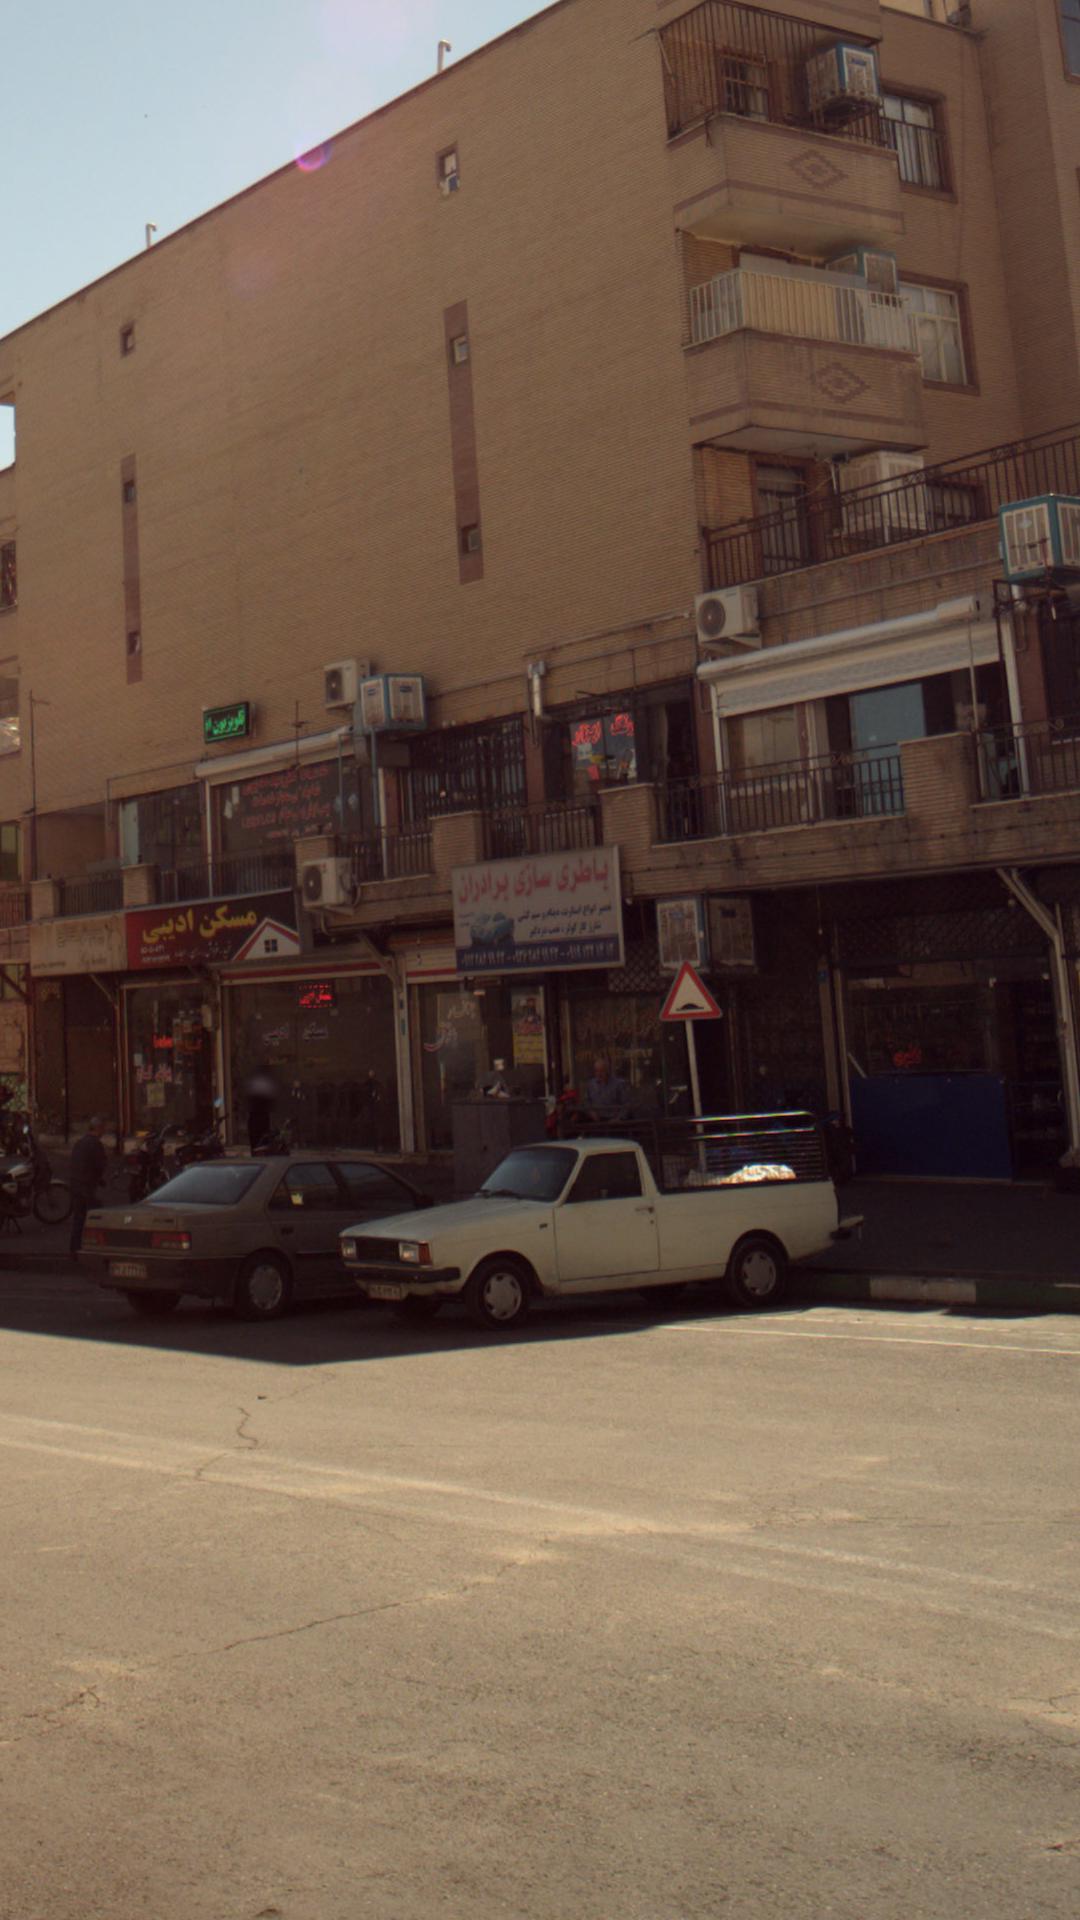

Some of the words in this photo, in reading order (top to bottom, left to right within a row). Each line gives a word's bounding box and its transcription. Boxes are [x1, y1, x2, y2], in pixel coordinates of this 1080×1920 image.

[458, 868, 509, 903] برادران
[514, 862, 551, 897] سازی
[557, 857, 609, 892] باطری
[142, 908, 194, 944] ادیبی
[199, 904, 257, 938] مسکن
